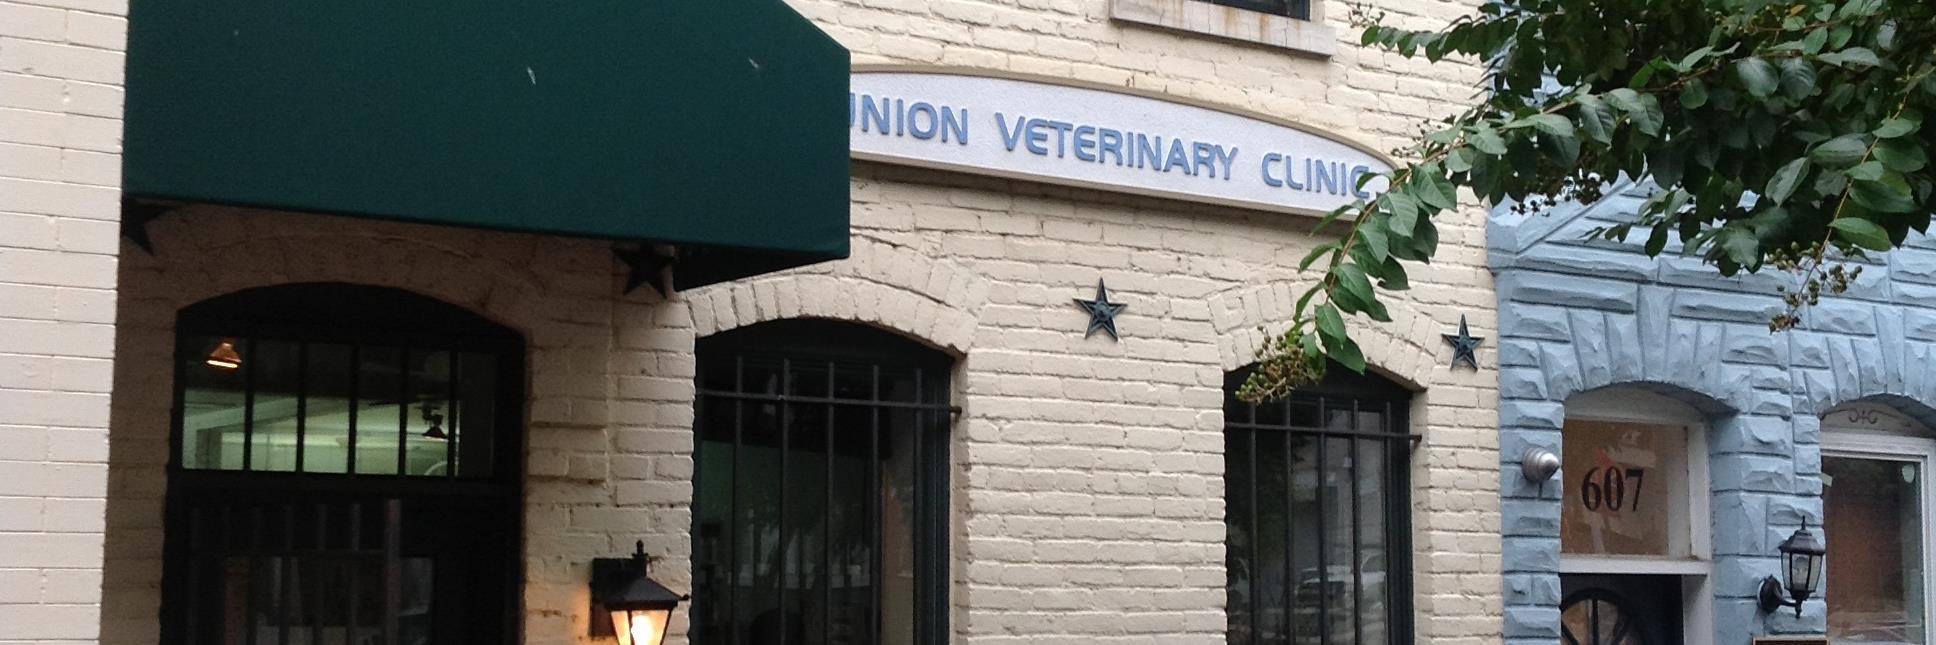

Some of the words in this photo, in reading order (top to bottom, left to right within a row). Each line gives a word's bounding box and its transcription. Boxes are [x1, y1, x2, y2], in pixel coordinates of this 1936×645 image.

[849, 92, 968, 145] NION
[994, 112, 1238, 180] VETERINARY
[1261, 152, 1370, 199] CLINIC
[1581, 466, 1644, 511] 607
